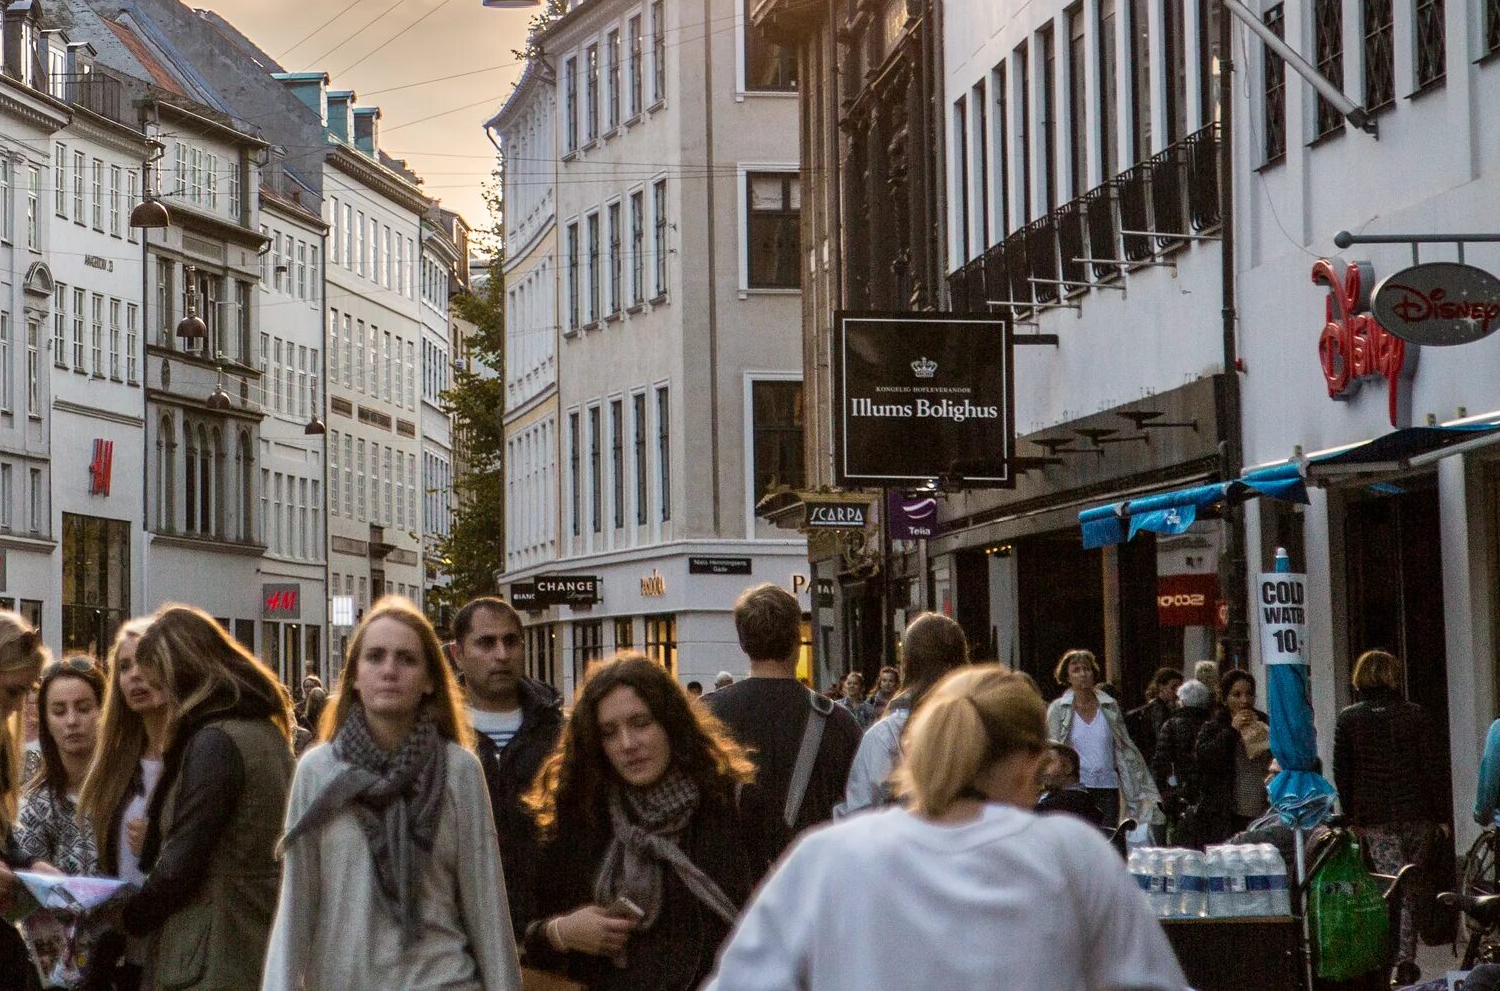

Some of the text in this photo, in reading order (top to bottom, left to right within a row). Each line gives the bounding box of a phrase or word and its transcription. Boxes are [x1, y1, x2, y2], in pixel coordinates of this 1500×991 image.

[851, 398, 998, 423] Illums Bolighus
[810, 507, 864, 522] SCARPA
[908, 526, 931, 536] Telia
[537, 582, 593, 591] CHANGE
